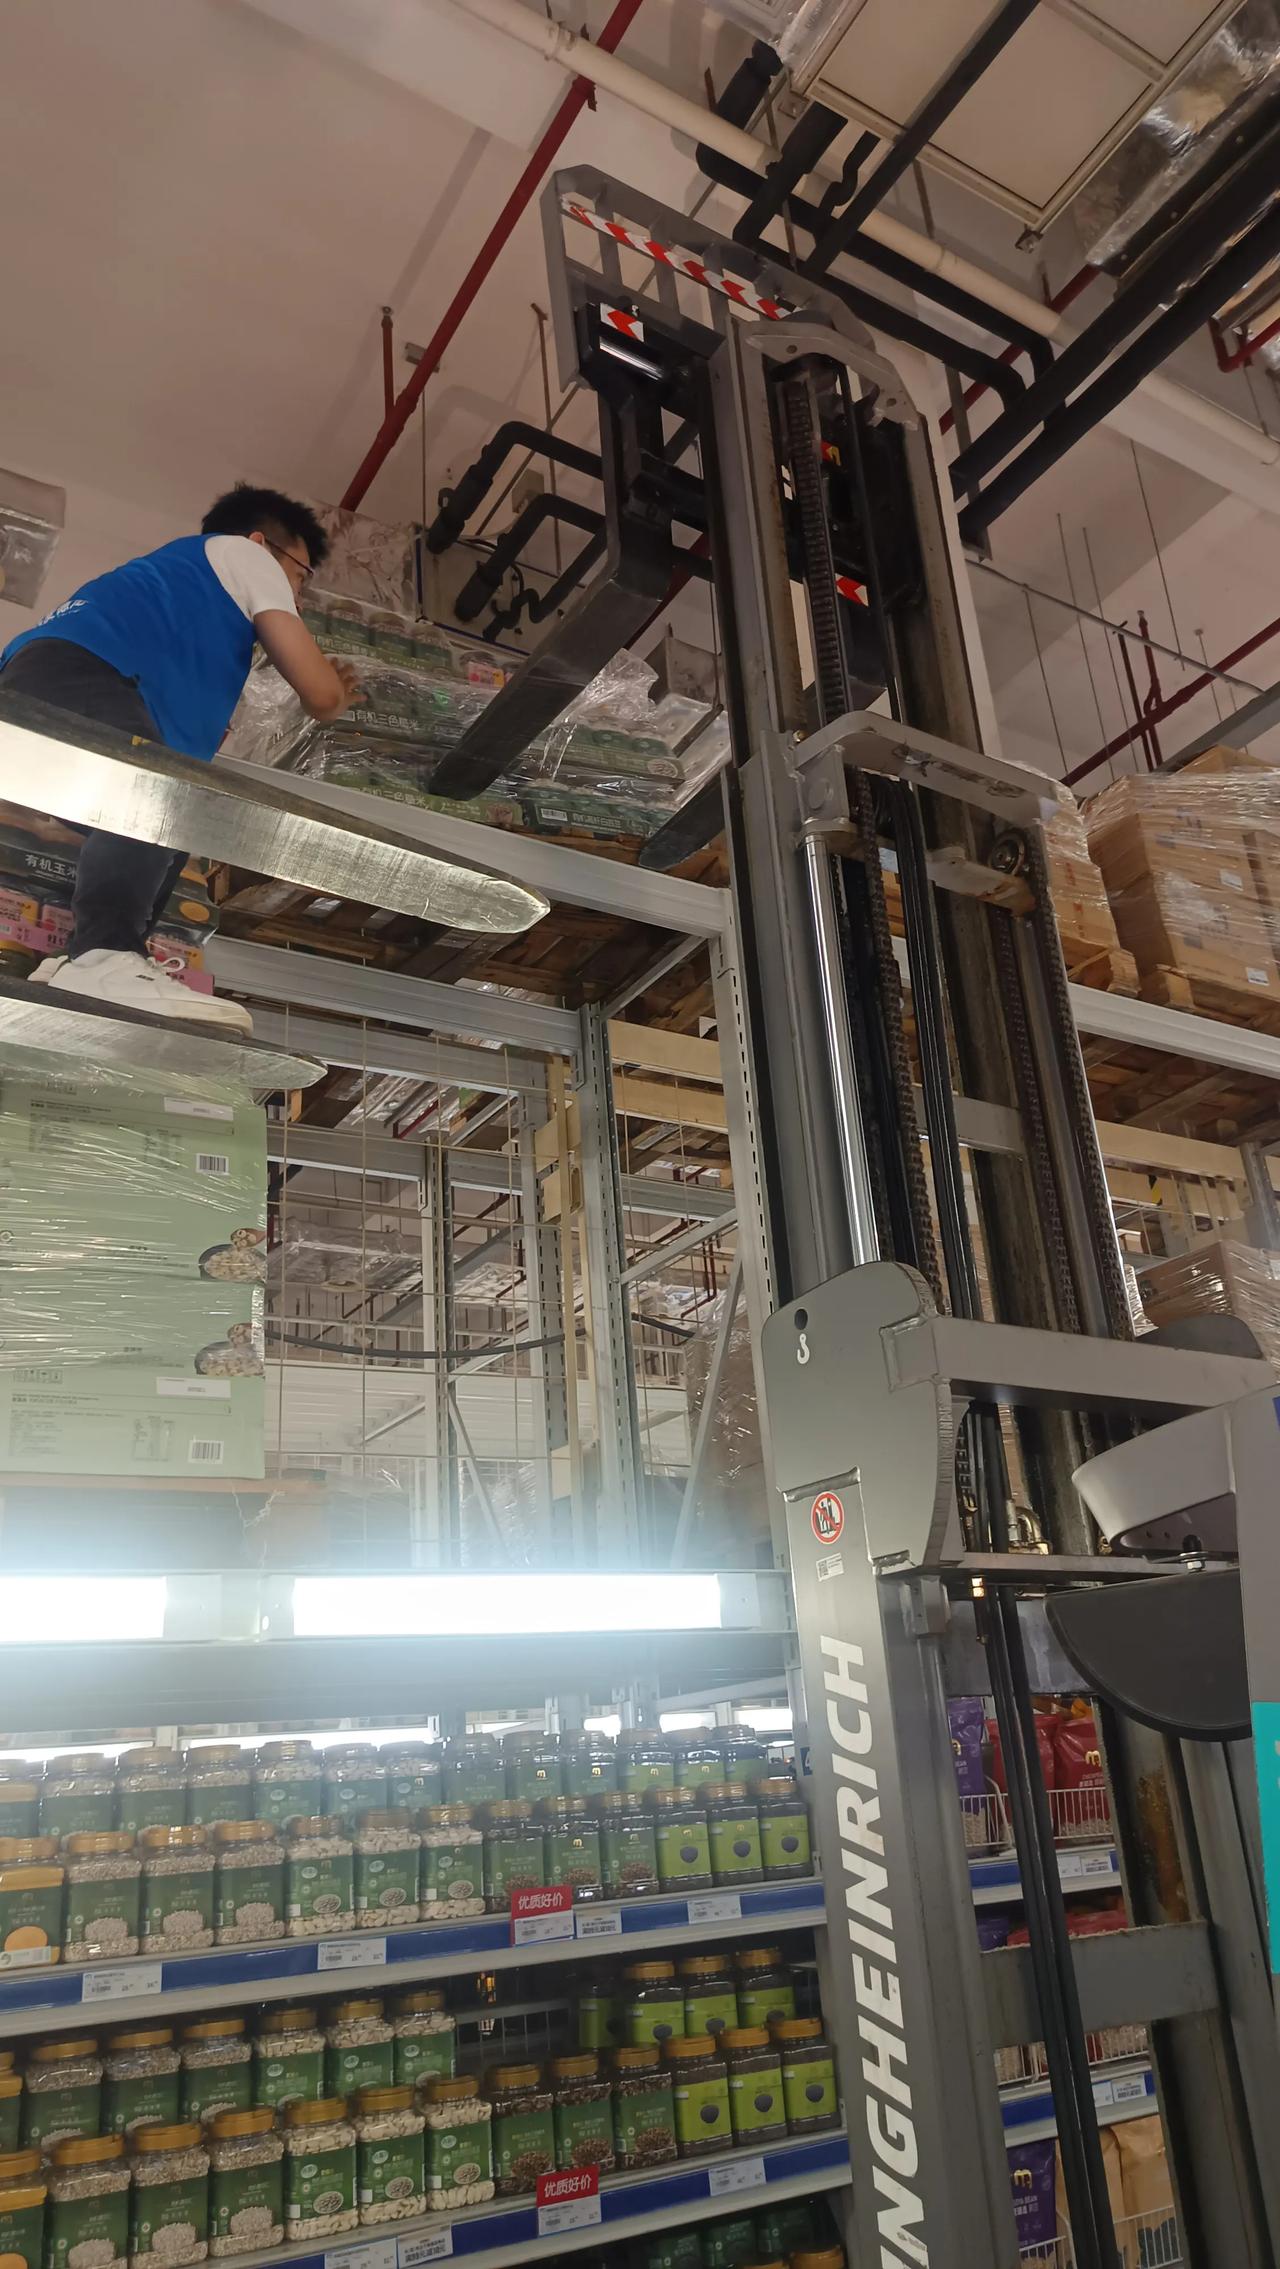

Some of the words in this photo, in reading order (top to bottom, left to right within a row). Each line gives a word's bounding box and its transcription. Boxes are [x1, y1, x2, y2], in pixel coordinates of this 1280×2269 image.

[518, 1892, 564, 1910] 优质好价
[544, 2174, 593, 2198] 优质好价
